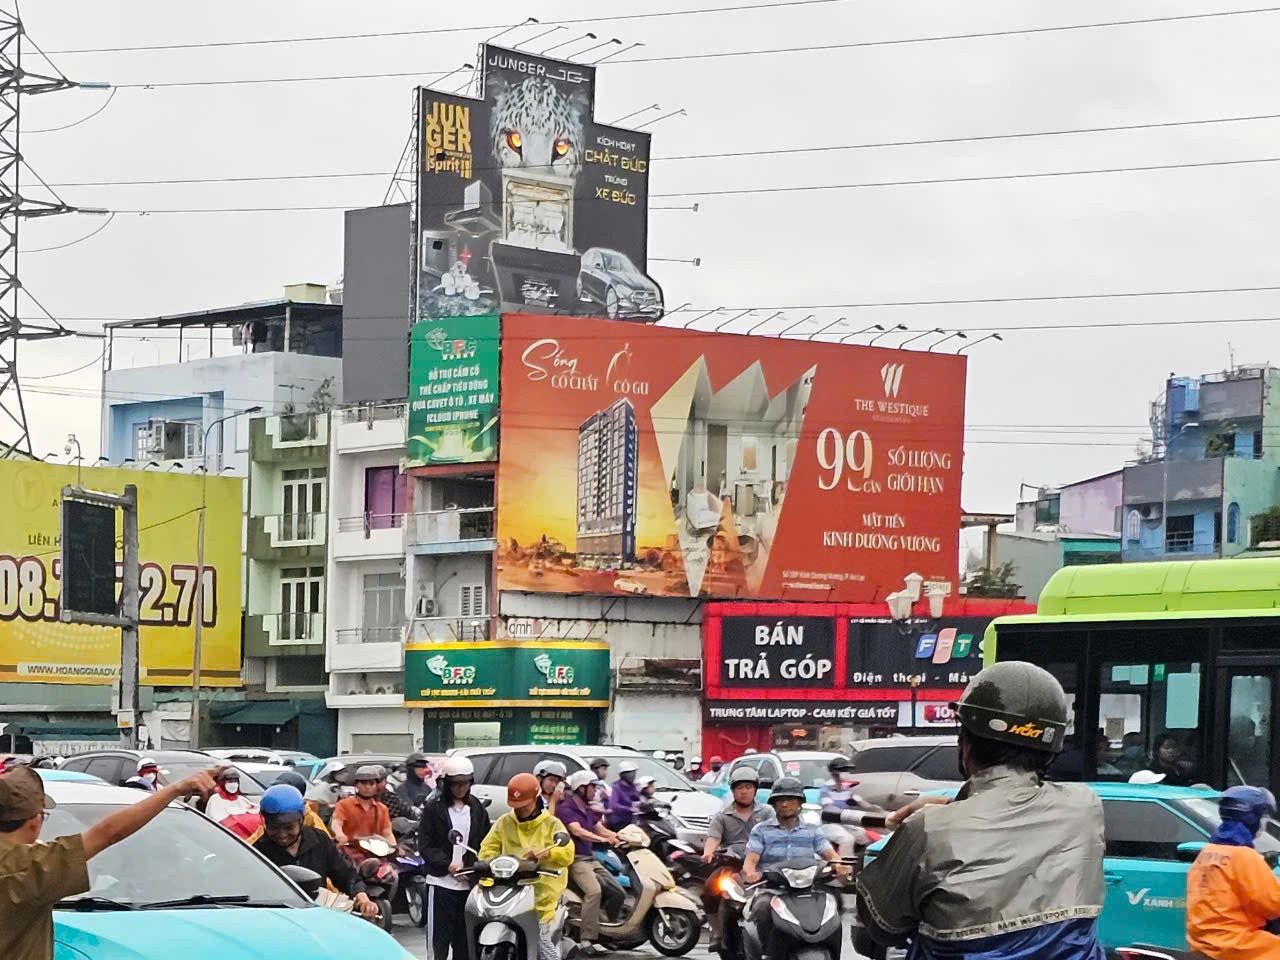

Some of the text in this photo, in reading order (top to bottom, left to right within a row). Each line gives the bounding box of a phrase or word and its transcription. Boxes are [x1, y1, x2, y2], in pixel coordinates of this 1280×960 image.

[489, 55, 545, 76] JUNGER
[426, 101, 469, 129] JUN
[426, 124, 471, 153] GER
[595, 187, 610, 200] XE
[854, 398, 929, 418] THE WESTIQUE
[816, 427, 873, 492] 99
[887, 445, 951, 472] SỐ LƯỢNG
[887, 472, 944, 496] GIỚI HẠN
[28, 532, 50, 546] LIÊN
[823, 530, 940, 553] KINH DƯƠNG VƯƠNG
[754, 620, 804, 646] BÁN
[724, 651, 832, 679] TRẢ GÓP
[853, 672, 882, 685] Điện
[710, 707, 745, 718] TRUNG
[745, 706, 766, 718] TÂM
[767, 708, 806, 718] LAPTOP
[813, 708, 836, 718] CAM
[837, 704, 857, 718] KẾT
[857, 706, 876, 718] GIÁ
[876, 706, 897, 718] TỐT
